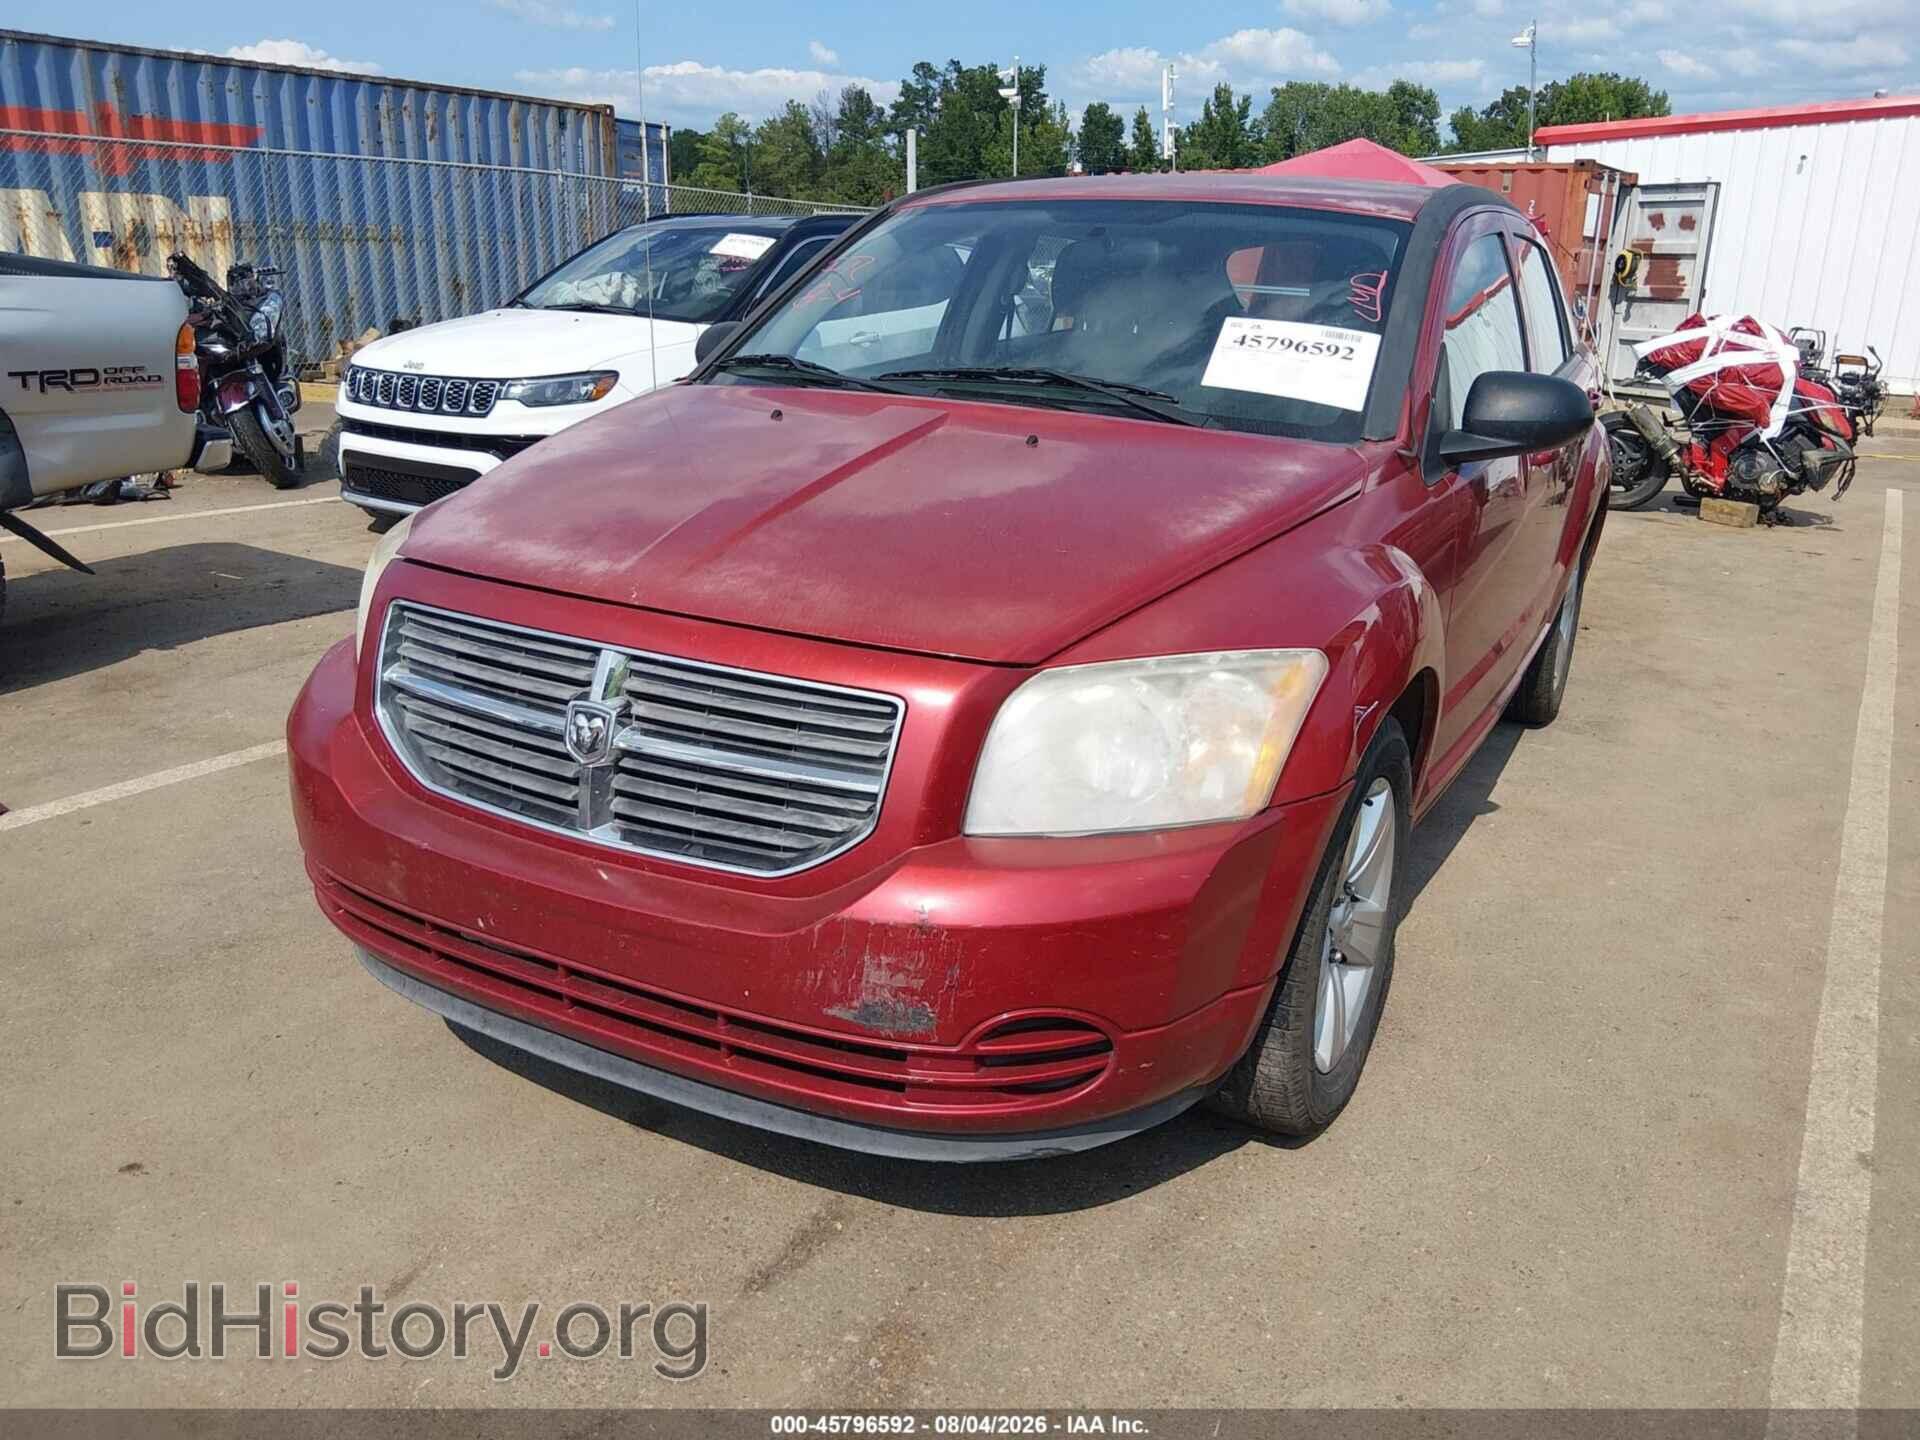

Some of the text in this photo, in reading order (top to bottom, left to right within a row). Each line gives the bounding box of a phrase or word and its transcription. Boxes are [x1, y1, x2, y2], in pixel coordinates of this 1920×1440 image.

[1233, 333, 1355, 361] 45796592
[7, 368, 100, 393] TRD
[103, 366, 146, 375] OFF
[103, 374, 162, 385] ROAD
